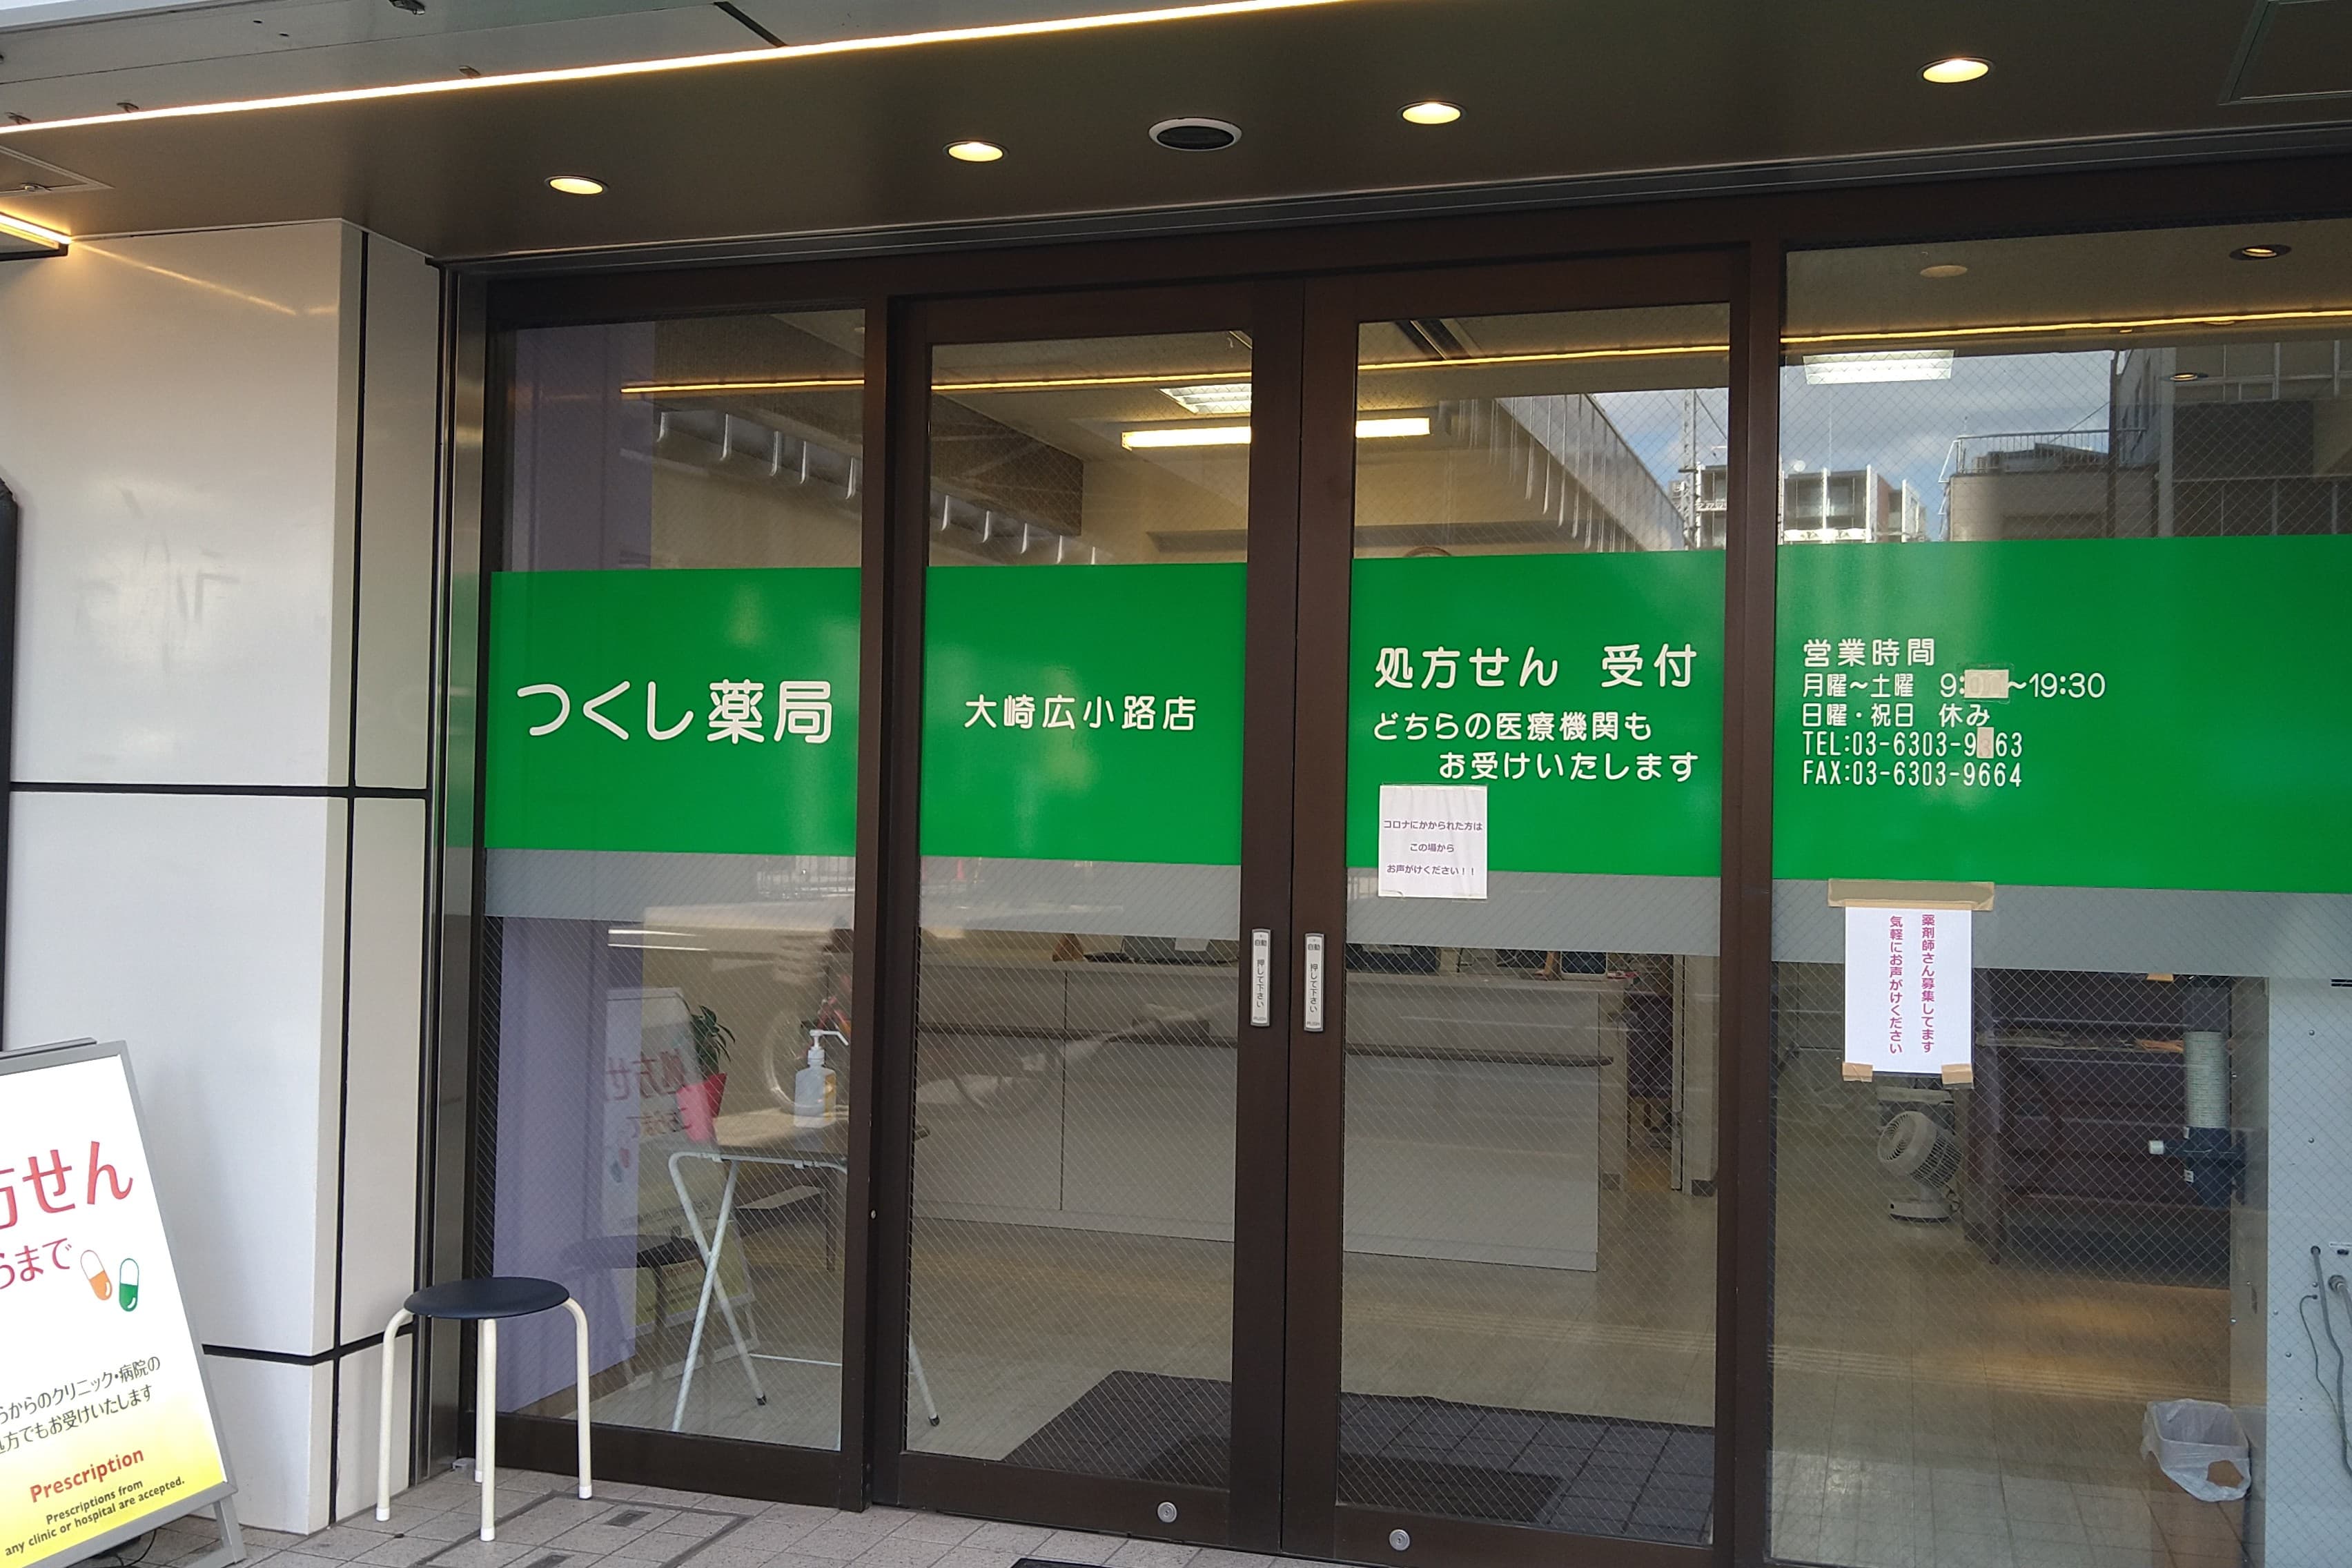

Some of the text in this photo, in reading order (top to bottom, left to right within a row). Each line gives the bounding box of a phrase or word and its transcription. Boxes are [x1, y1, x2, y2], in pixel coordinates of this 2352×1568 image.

[1375, 644, 1697, 689] 処方せん 受付
[1803, 638, 1935, 668] 営業時間
[517, 678, 832, 744] つくし薬局
[964, 694, 1197, 731] 大崎広小路店
[1373, 711, 1652, 741] どちらの医療機関も
[1803, 703, 1990, 727] 日曜・祝日 休み
[1803, 730, 2023, 758] TEL:03-6303-963
[1438, 751, 1698, 782] お受けいたします
[1803, 760, 2023, 787] FAX:03-6303-9664
[1383, 820, 1483, 831] コロナにかかられた方は
[1410, 843, 1455, 853] この場から
[1256, 959, 1265, 1008] 押して下さい
[1309, 963, 1319, 1012] 押して下さい
[1889, 915, 1903, 1054] 気軽にお声がけください
[1921, 914, 1935, 1053] 薬剤師さん募集してます
[30, 1449, 144, 1503] Prescription
[5, 1476, 186, 1556] any clinic or hospital are accepted.
[46, 1480, 144, 1525] Prescriptions from
